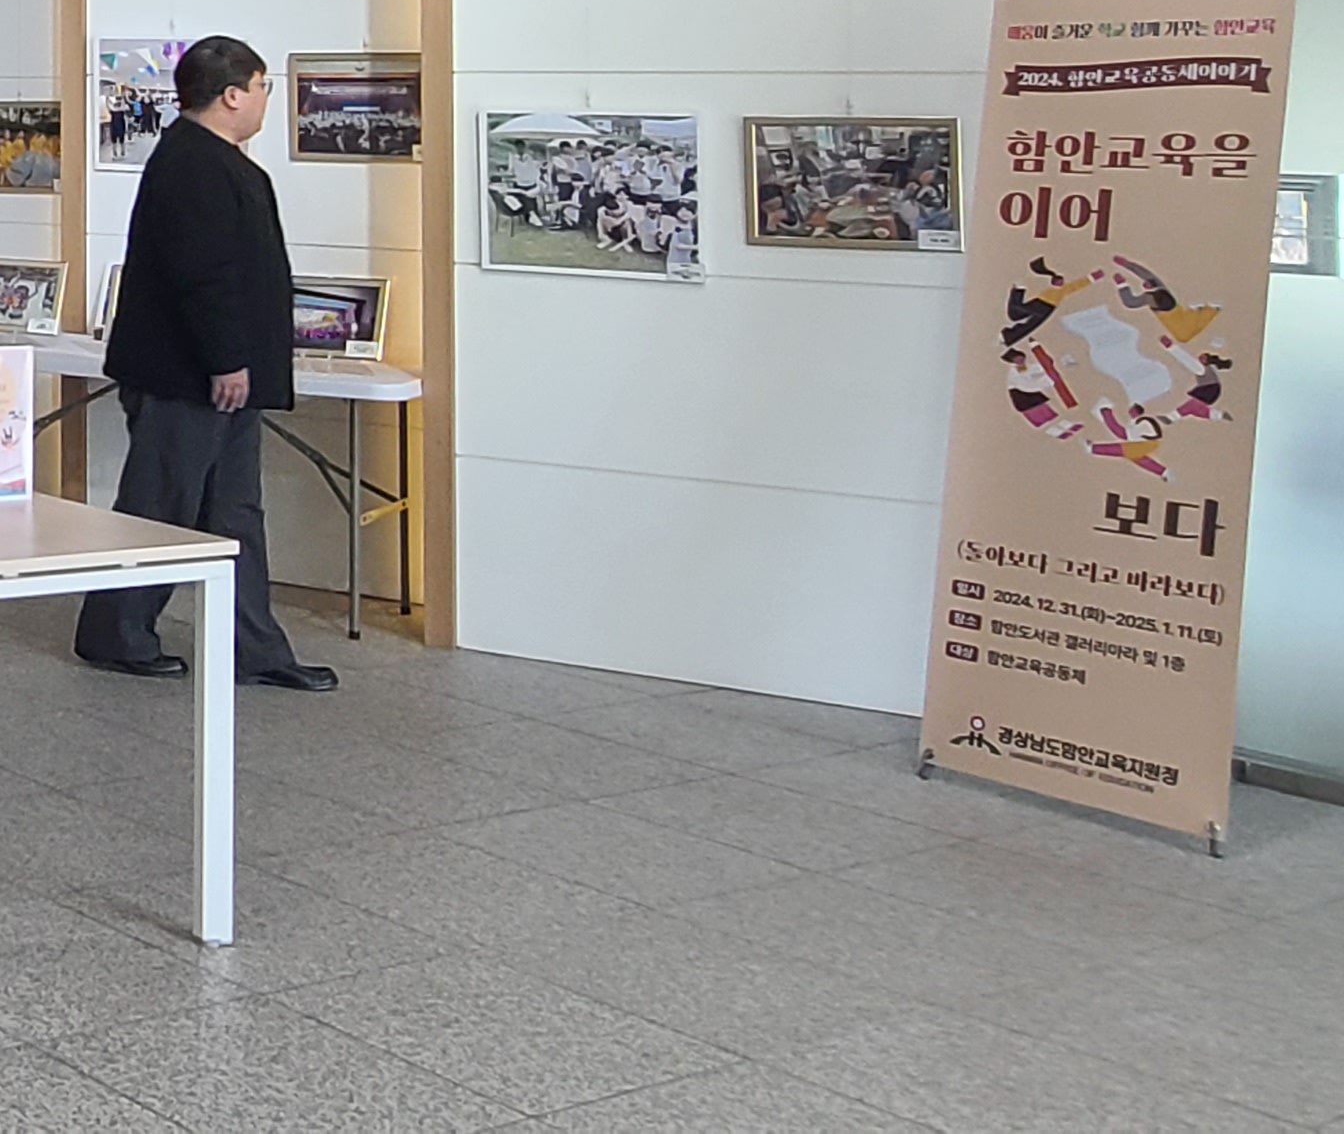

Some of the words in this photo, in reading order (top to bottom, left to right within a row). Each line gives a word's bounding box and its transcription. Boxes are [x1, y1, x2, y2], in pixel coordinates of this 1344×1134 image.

[1164, 21, 1209, 37] 가꾸는
[1214, 18, 1277, 36] 함안교육
[1006, 130, 1258, 179] 함안교육을
[999, 186, 1114, 242] 이어
[1091, 492, 1227, 557] 보다
[957, 539, 1048, 574] (돌아보다
[1054, 558, 1120, 584] 그리고
[1126, 571, 1226, 606] 바라보다)
[993, 589, 1034, 609] 2024.
[1037, 598, 1057, 613] 12.
[952, 612, 979, 627] 장소
[991, 619, 1061, 647] 함안도서관
[1064, 634, 1139, 662] 갤러리아라
[1142, 649, 1159, 667] 및
[986, 650, 1086, 685] 함안교육공동체
[997, 725, 1180, 786] 경상남도함안교육지원청
